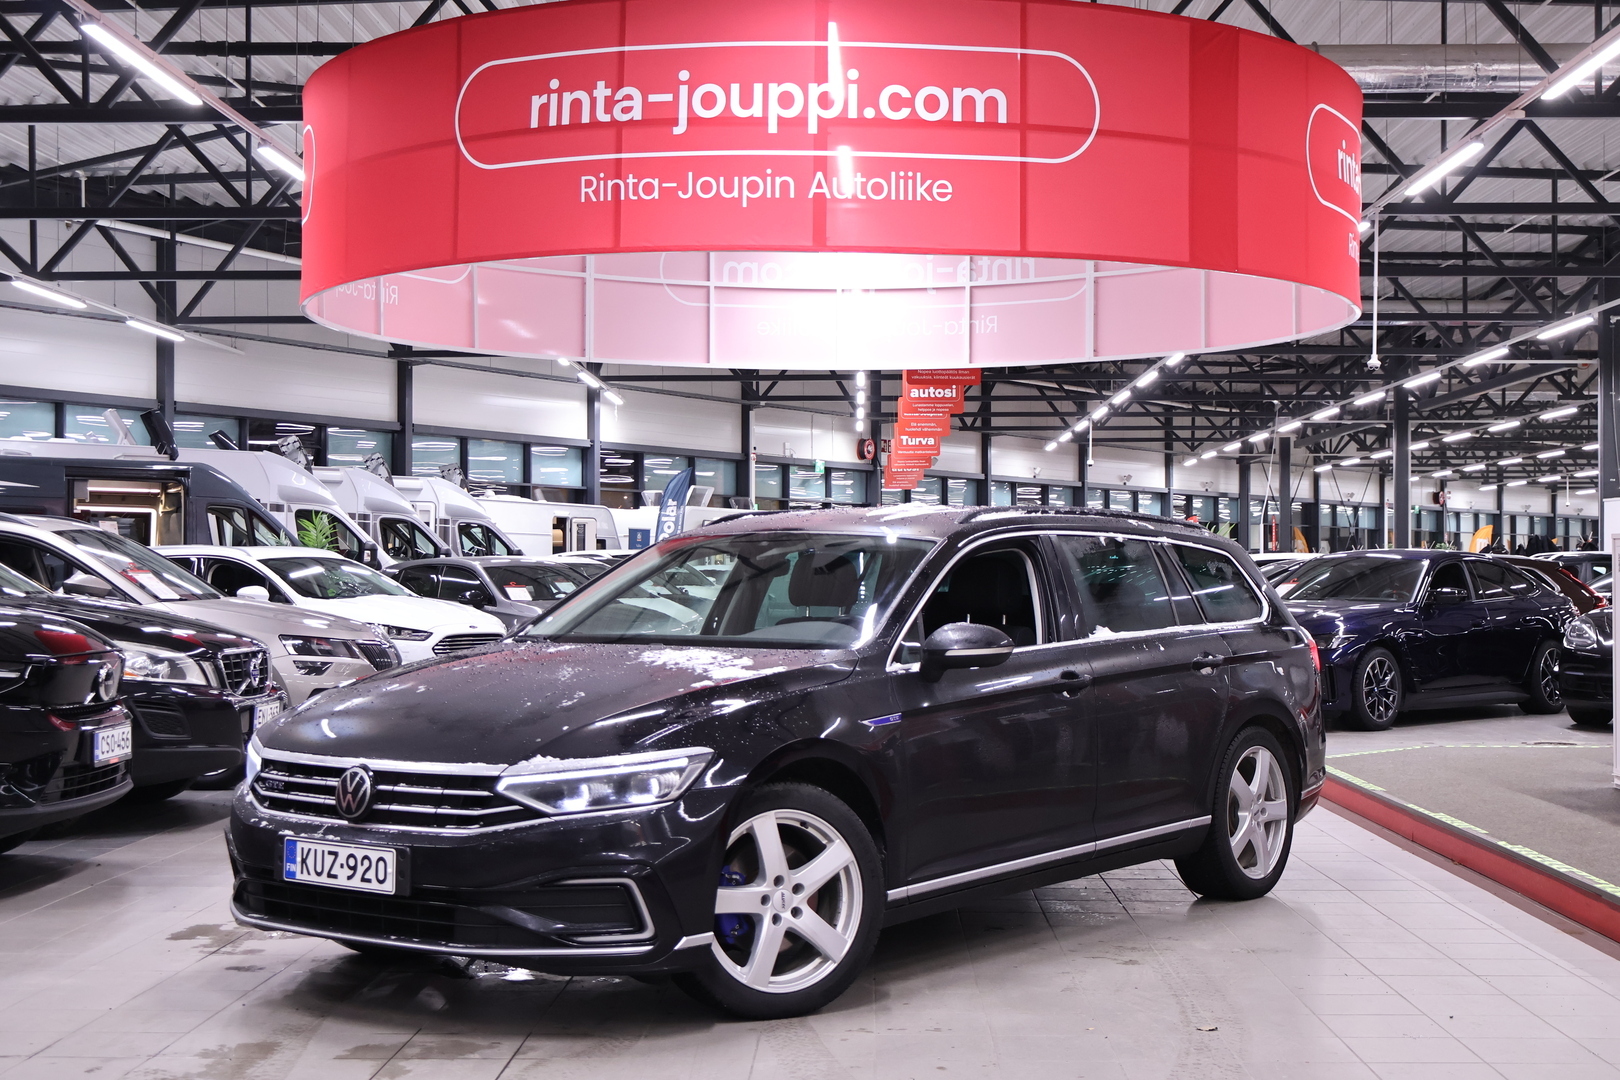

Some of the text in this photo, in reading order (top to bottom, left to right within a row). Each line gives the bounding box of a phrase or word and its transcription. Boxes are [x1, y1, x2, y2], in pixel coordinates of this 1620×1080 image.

[530, 69, 1008, 135] rinta-jouppi.com
[580, 169, 953, 207] Rinta-Joupin Autoliike
[910, 385, 956, 398] autosi
[900, 435, 935, 446] Turva
[286, 846, 388, 886] FIN KUZ-920
